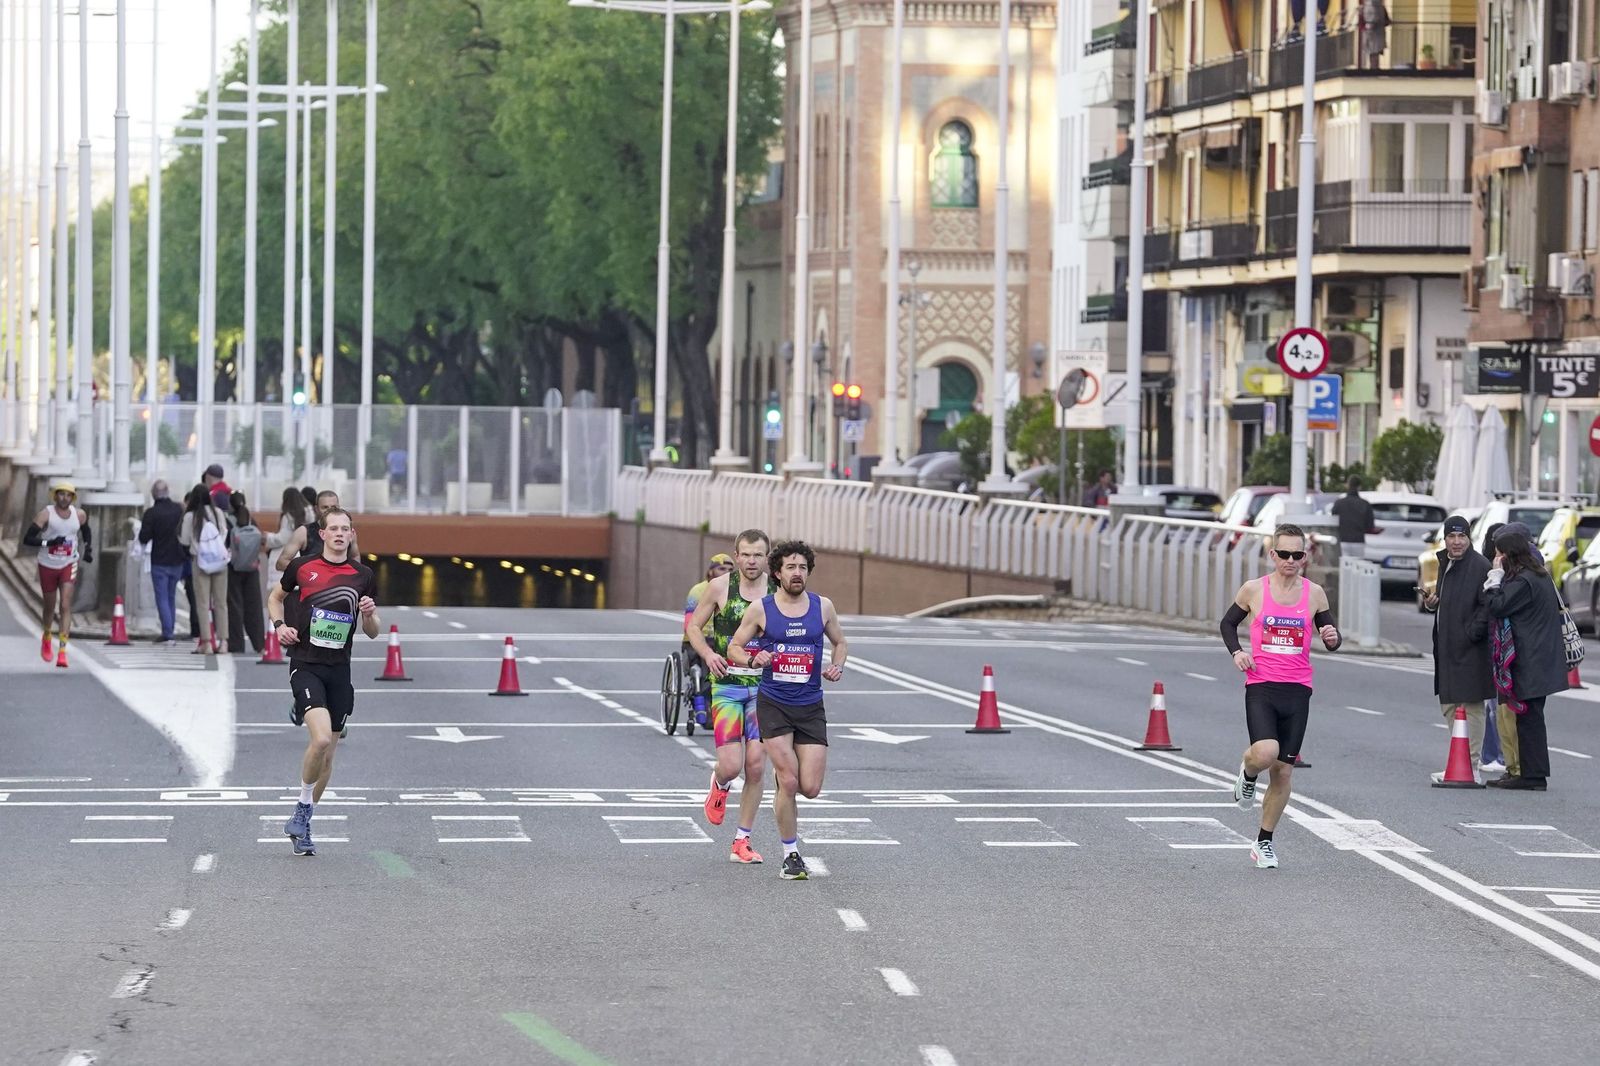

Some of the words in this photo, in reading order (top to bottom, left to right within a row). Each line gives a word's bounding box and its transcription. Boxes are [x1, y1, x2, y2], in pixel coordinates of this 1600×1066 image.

[1538, 357, 1596, 373] TINTE
[1552, 372, 1589, 397] 5€
[1309, 380, 1331, 409] P
[326, 612, 349, 622] ZURICH
[315, 629, 343, 641] MARCO
[1271, 636, 1294, 646] NIELS
[787, 645, 811, 653] ZURICH
[779, 663, 809, 674] KAMIEL
